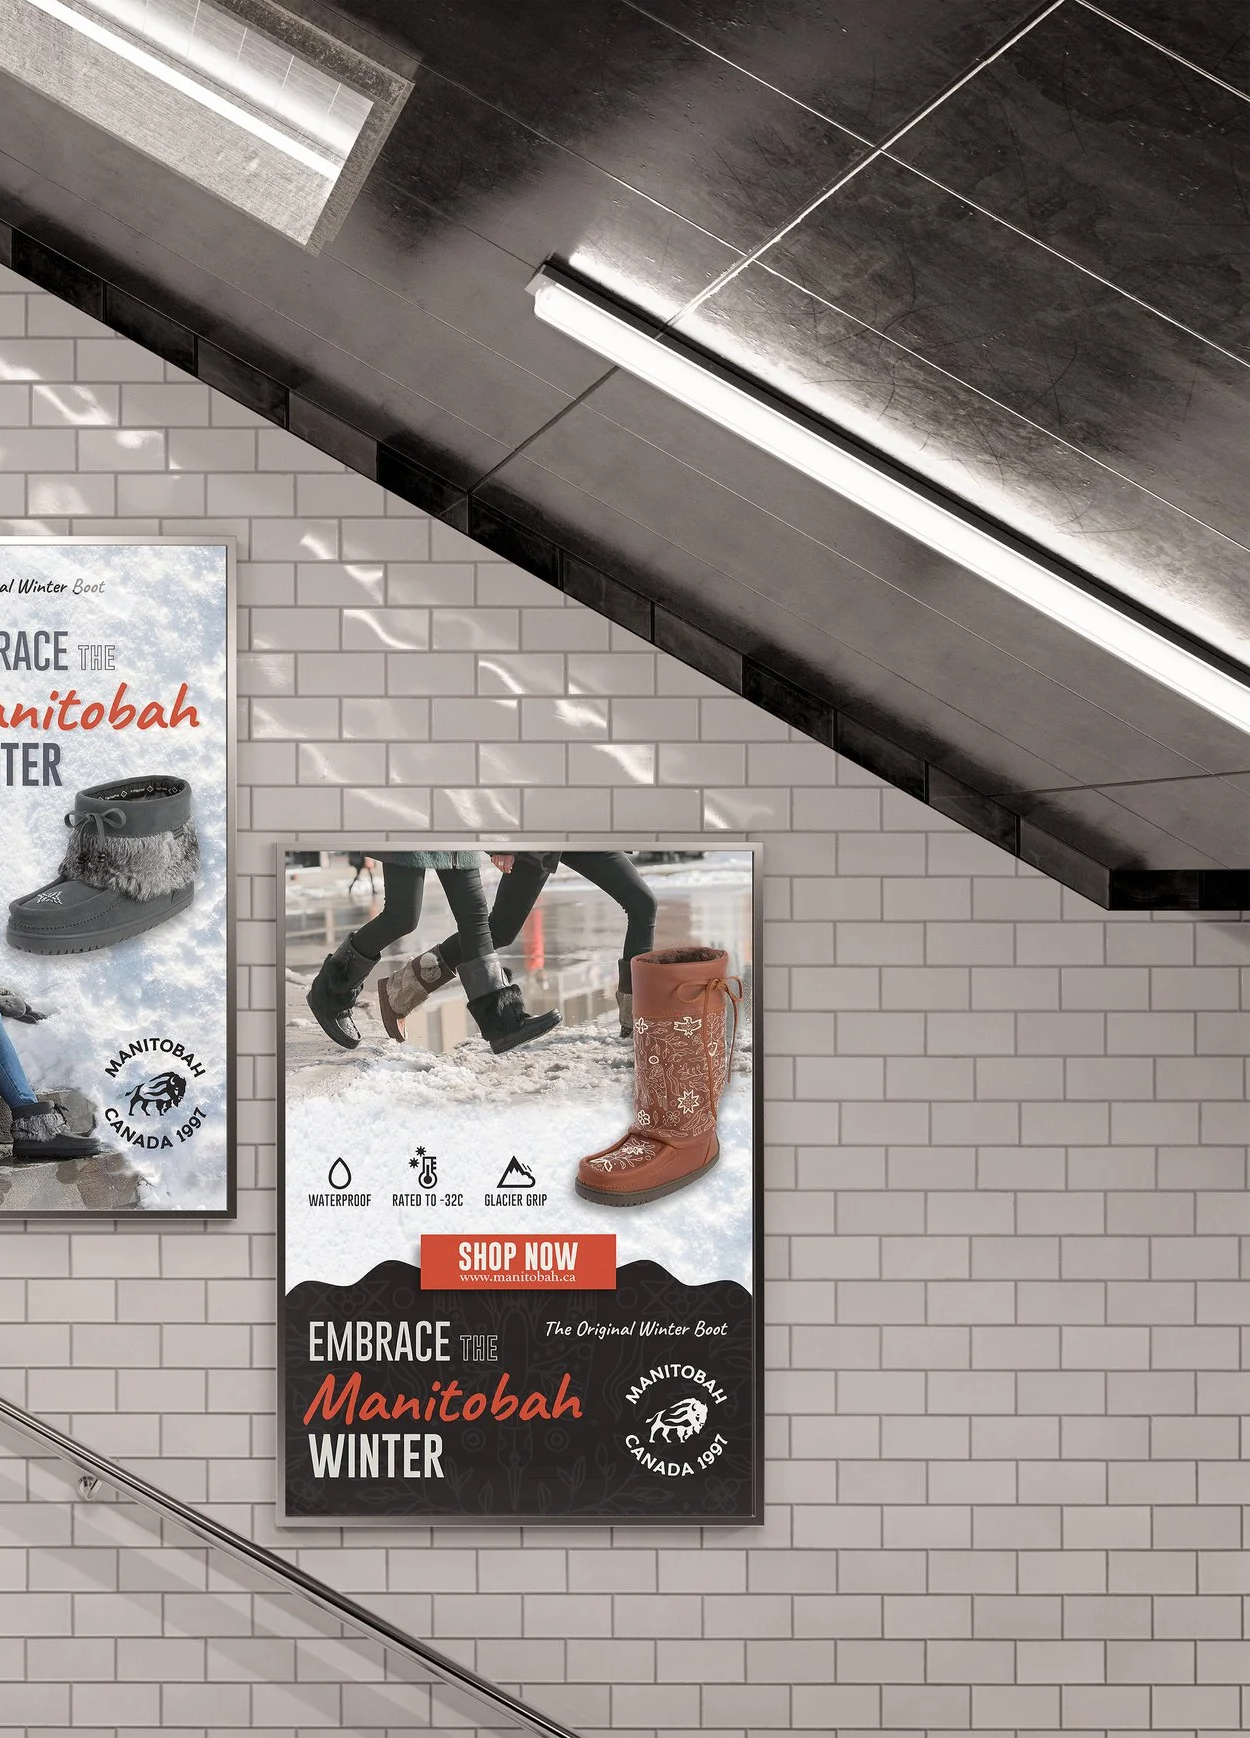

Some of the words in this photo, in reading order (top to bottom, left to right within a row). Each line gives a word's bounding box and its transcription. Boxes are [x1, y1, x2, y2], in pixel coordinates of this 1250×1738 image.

[18, 579, 68, 594] Winter
[72, 578, 105, 594] Boot
[77, 644, 115, 671] THE
[104, 1038, 206, 1078] MANITOBAH
[104, 1108, 174, 1150] CANADA
[176, 1107, 207, 1143] 1997
[309, 1194, 371, 1207] WATERPROOF
[392, 1194, 422, 1207] RATED
[425, 1194, 437, 1207] TO
[439, 1194, 463, 1207] -32C
[484, 1194, 522, 1207] GLACIER
[524, 1194, 547, 1207] GRIP
[459, 1242, 517, 1270] SHOP
[525, 1242, 578, 1270] NOW
[459, 1270, 576, 1284] www.manitobah.ca
[309, 1321, 450, 1361] EMBRACE
[460, 1334, 497, 1361] THE
[545, 1321, 572, 1336] The
[576, 1321, 634, 1339] Original
[639, 1322, 690, 1337] Winter
[695, 1322, 728, 1336] Boot
[303, 1371, 583, 1425] Manitobah
[625, 1364, 727, 1405] MANITOBAH
[308, 1434, 444, 1479] WINTER
[625, 1434, 695, 1477] CANADA
[696, 1434, 728, 1470] 1997
